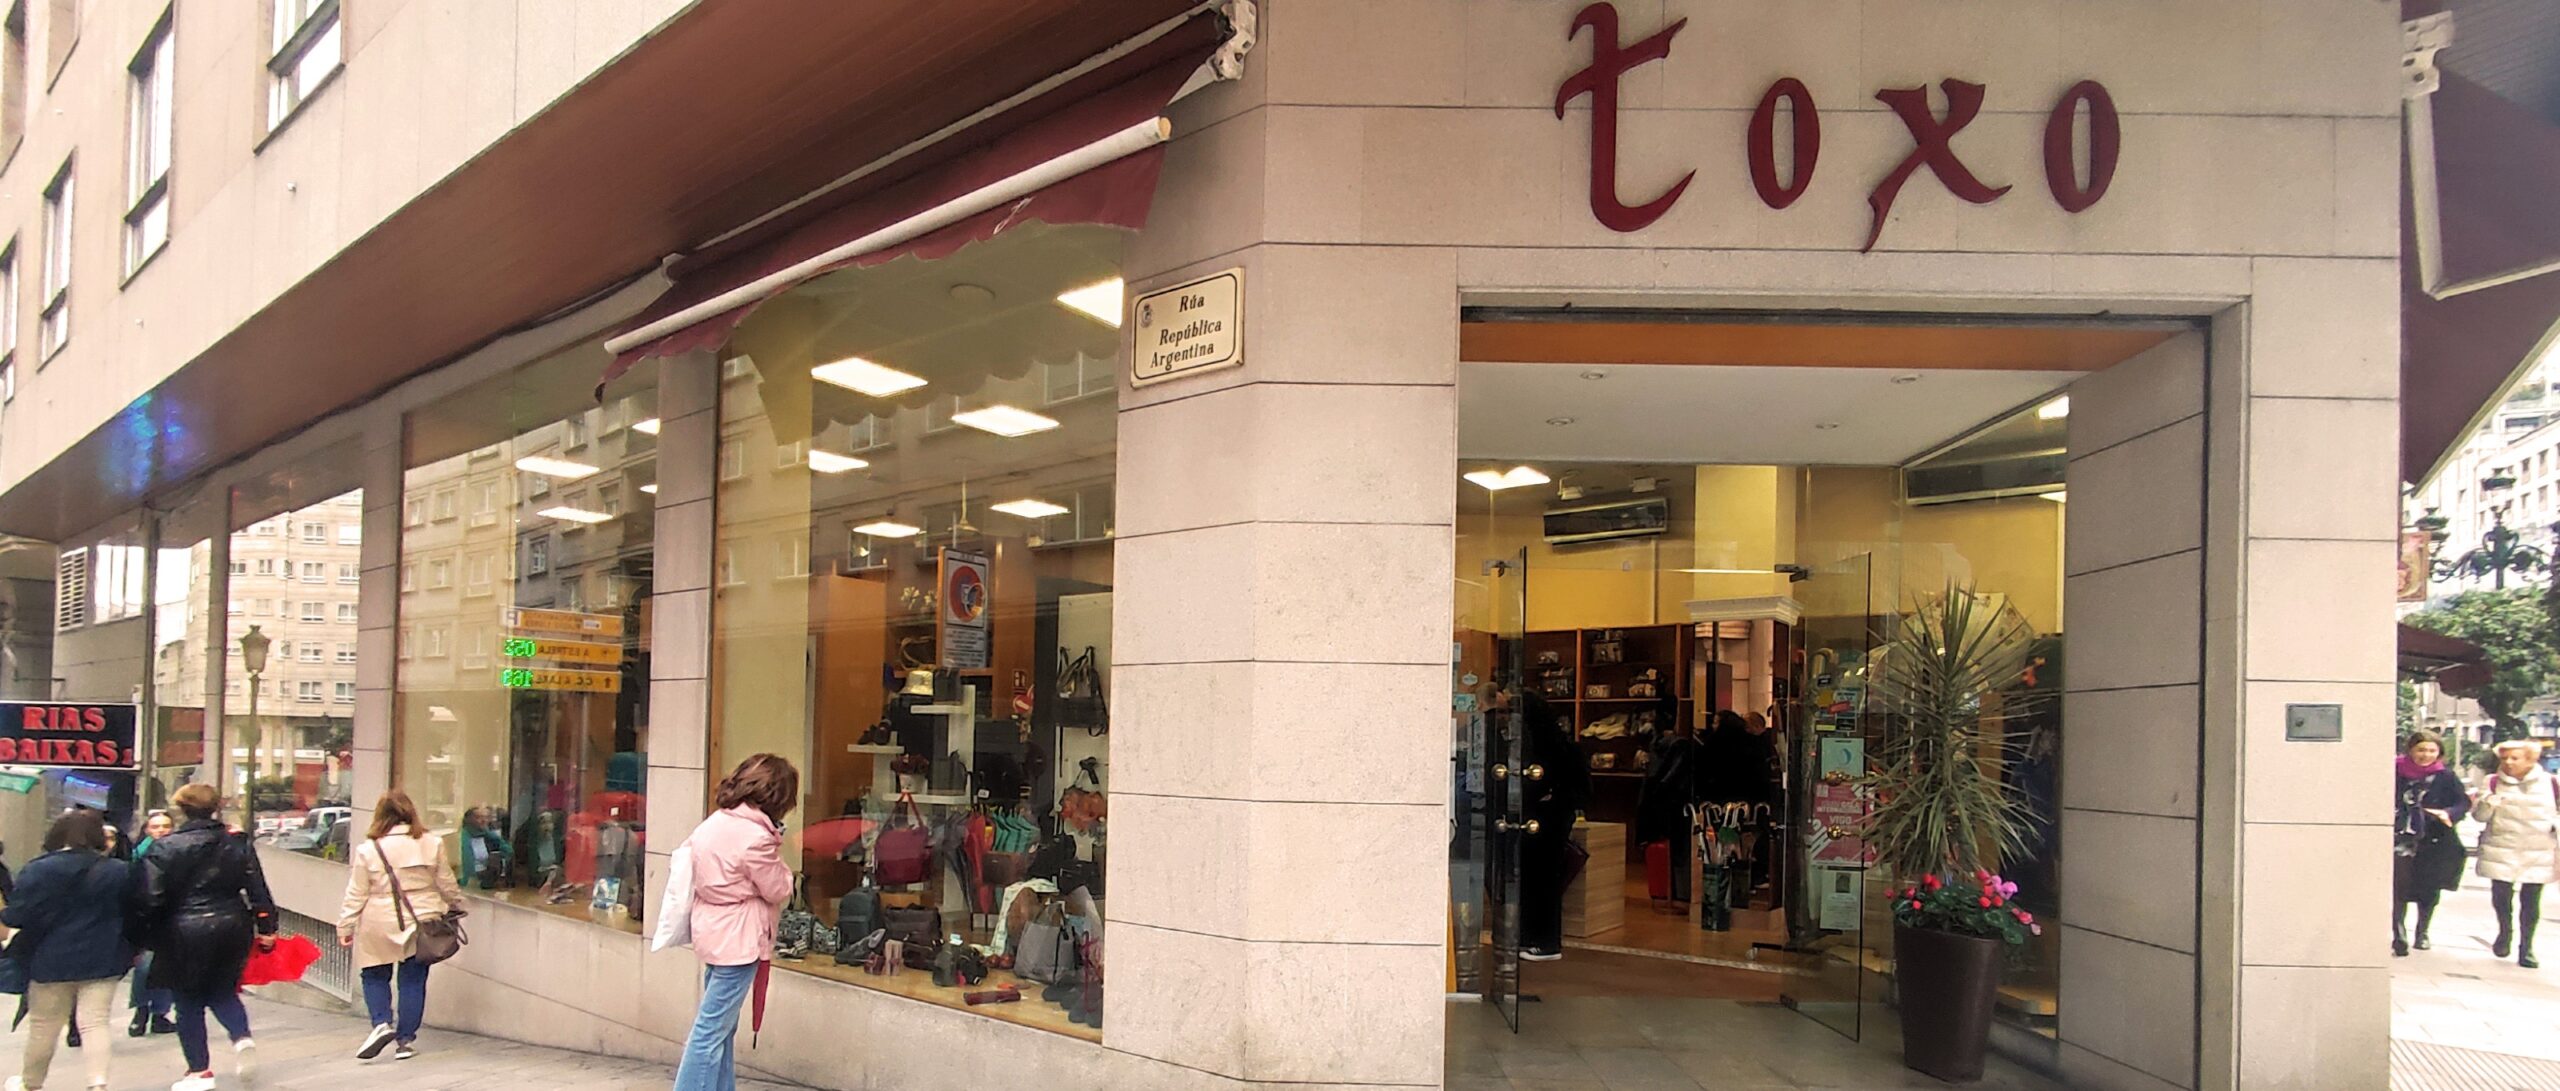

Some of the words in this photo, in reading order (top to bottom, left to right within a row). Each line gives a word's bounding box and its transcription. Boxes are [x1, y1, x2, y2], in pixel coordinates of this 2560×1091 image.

[1555, 2, 2120, 254] toxo
[1179, 294, 1205, 313] Rúa
[1159, 319, 1222, 347] República
[1150, 342, 1214, 371] Argentina
[22, 706, 106, 733] RIAS
[0, 737, 119, 765] BAIXAS
